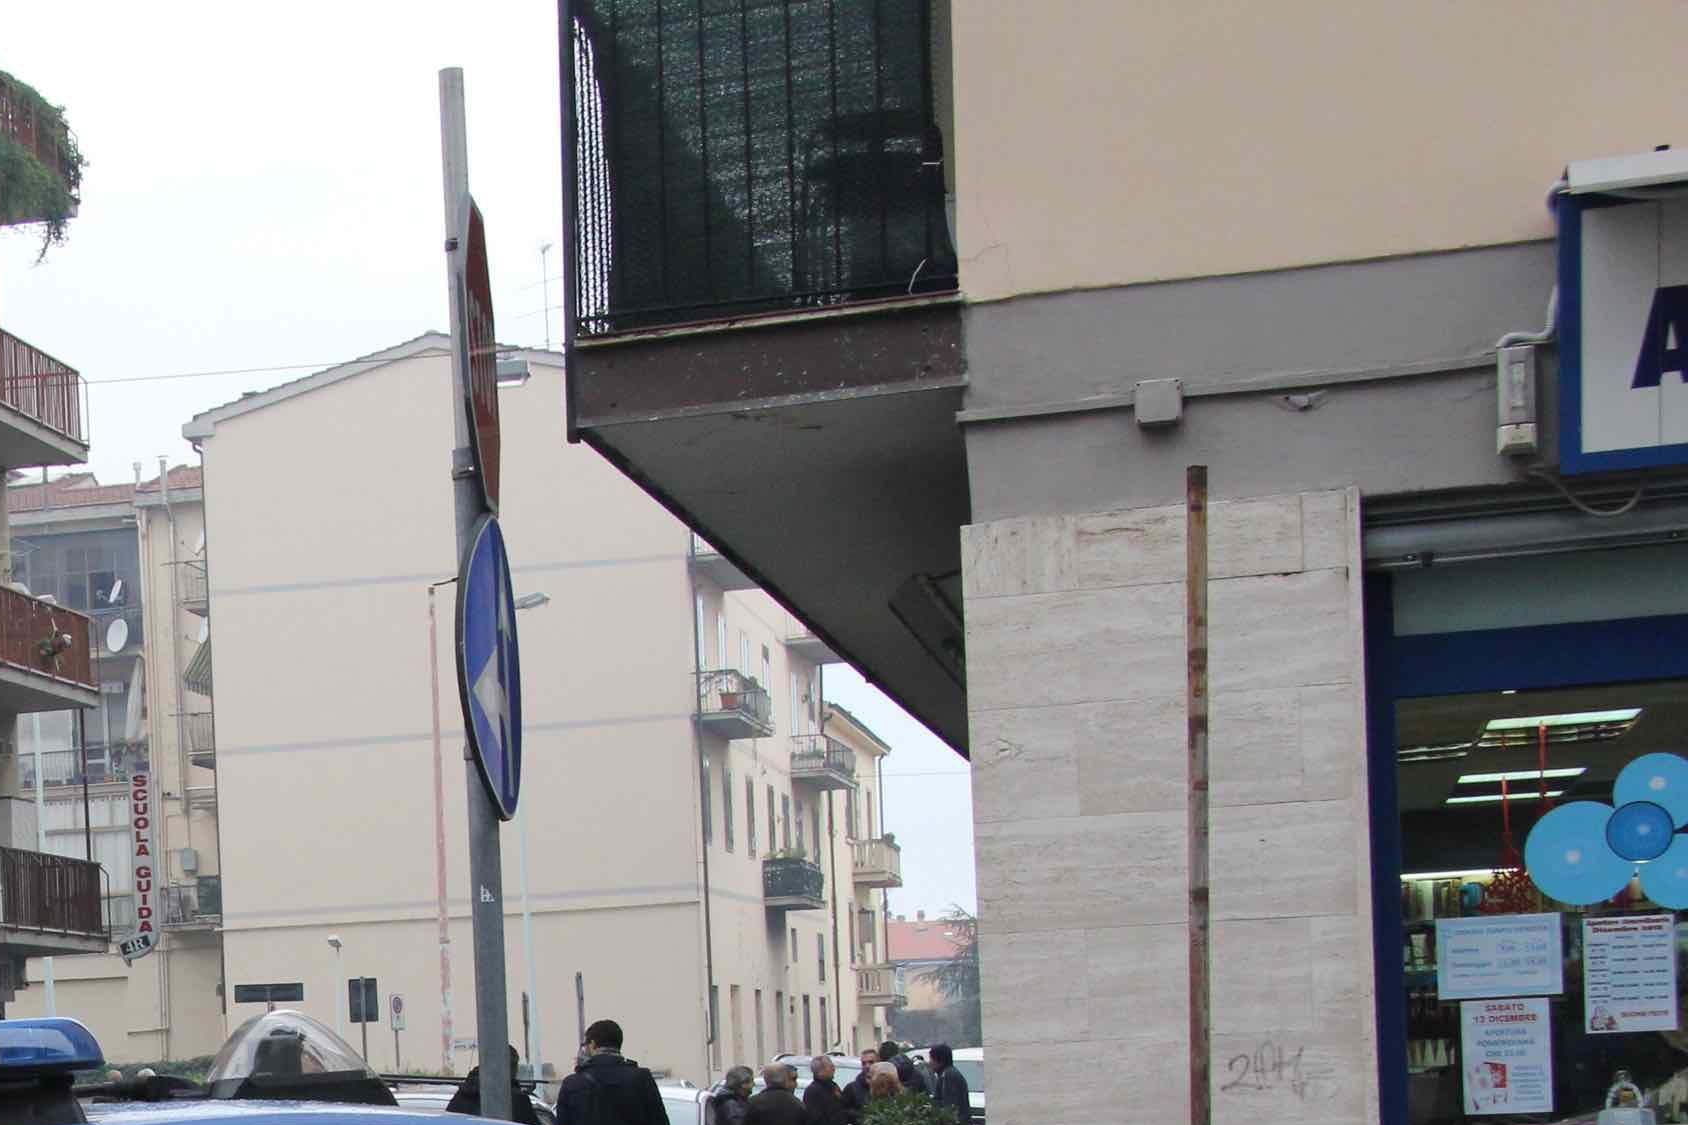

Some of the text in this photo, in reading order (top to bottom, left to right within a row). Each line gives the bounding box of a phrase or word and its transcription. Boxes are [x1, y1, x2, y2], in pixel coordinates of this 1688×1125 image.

[132, 775, 153, 933] SCUOLA GUIDA
[1485, 1003, 1525, 1012] SABATO
[1488, 1014, 1537, 1023] DICEMBRE
